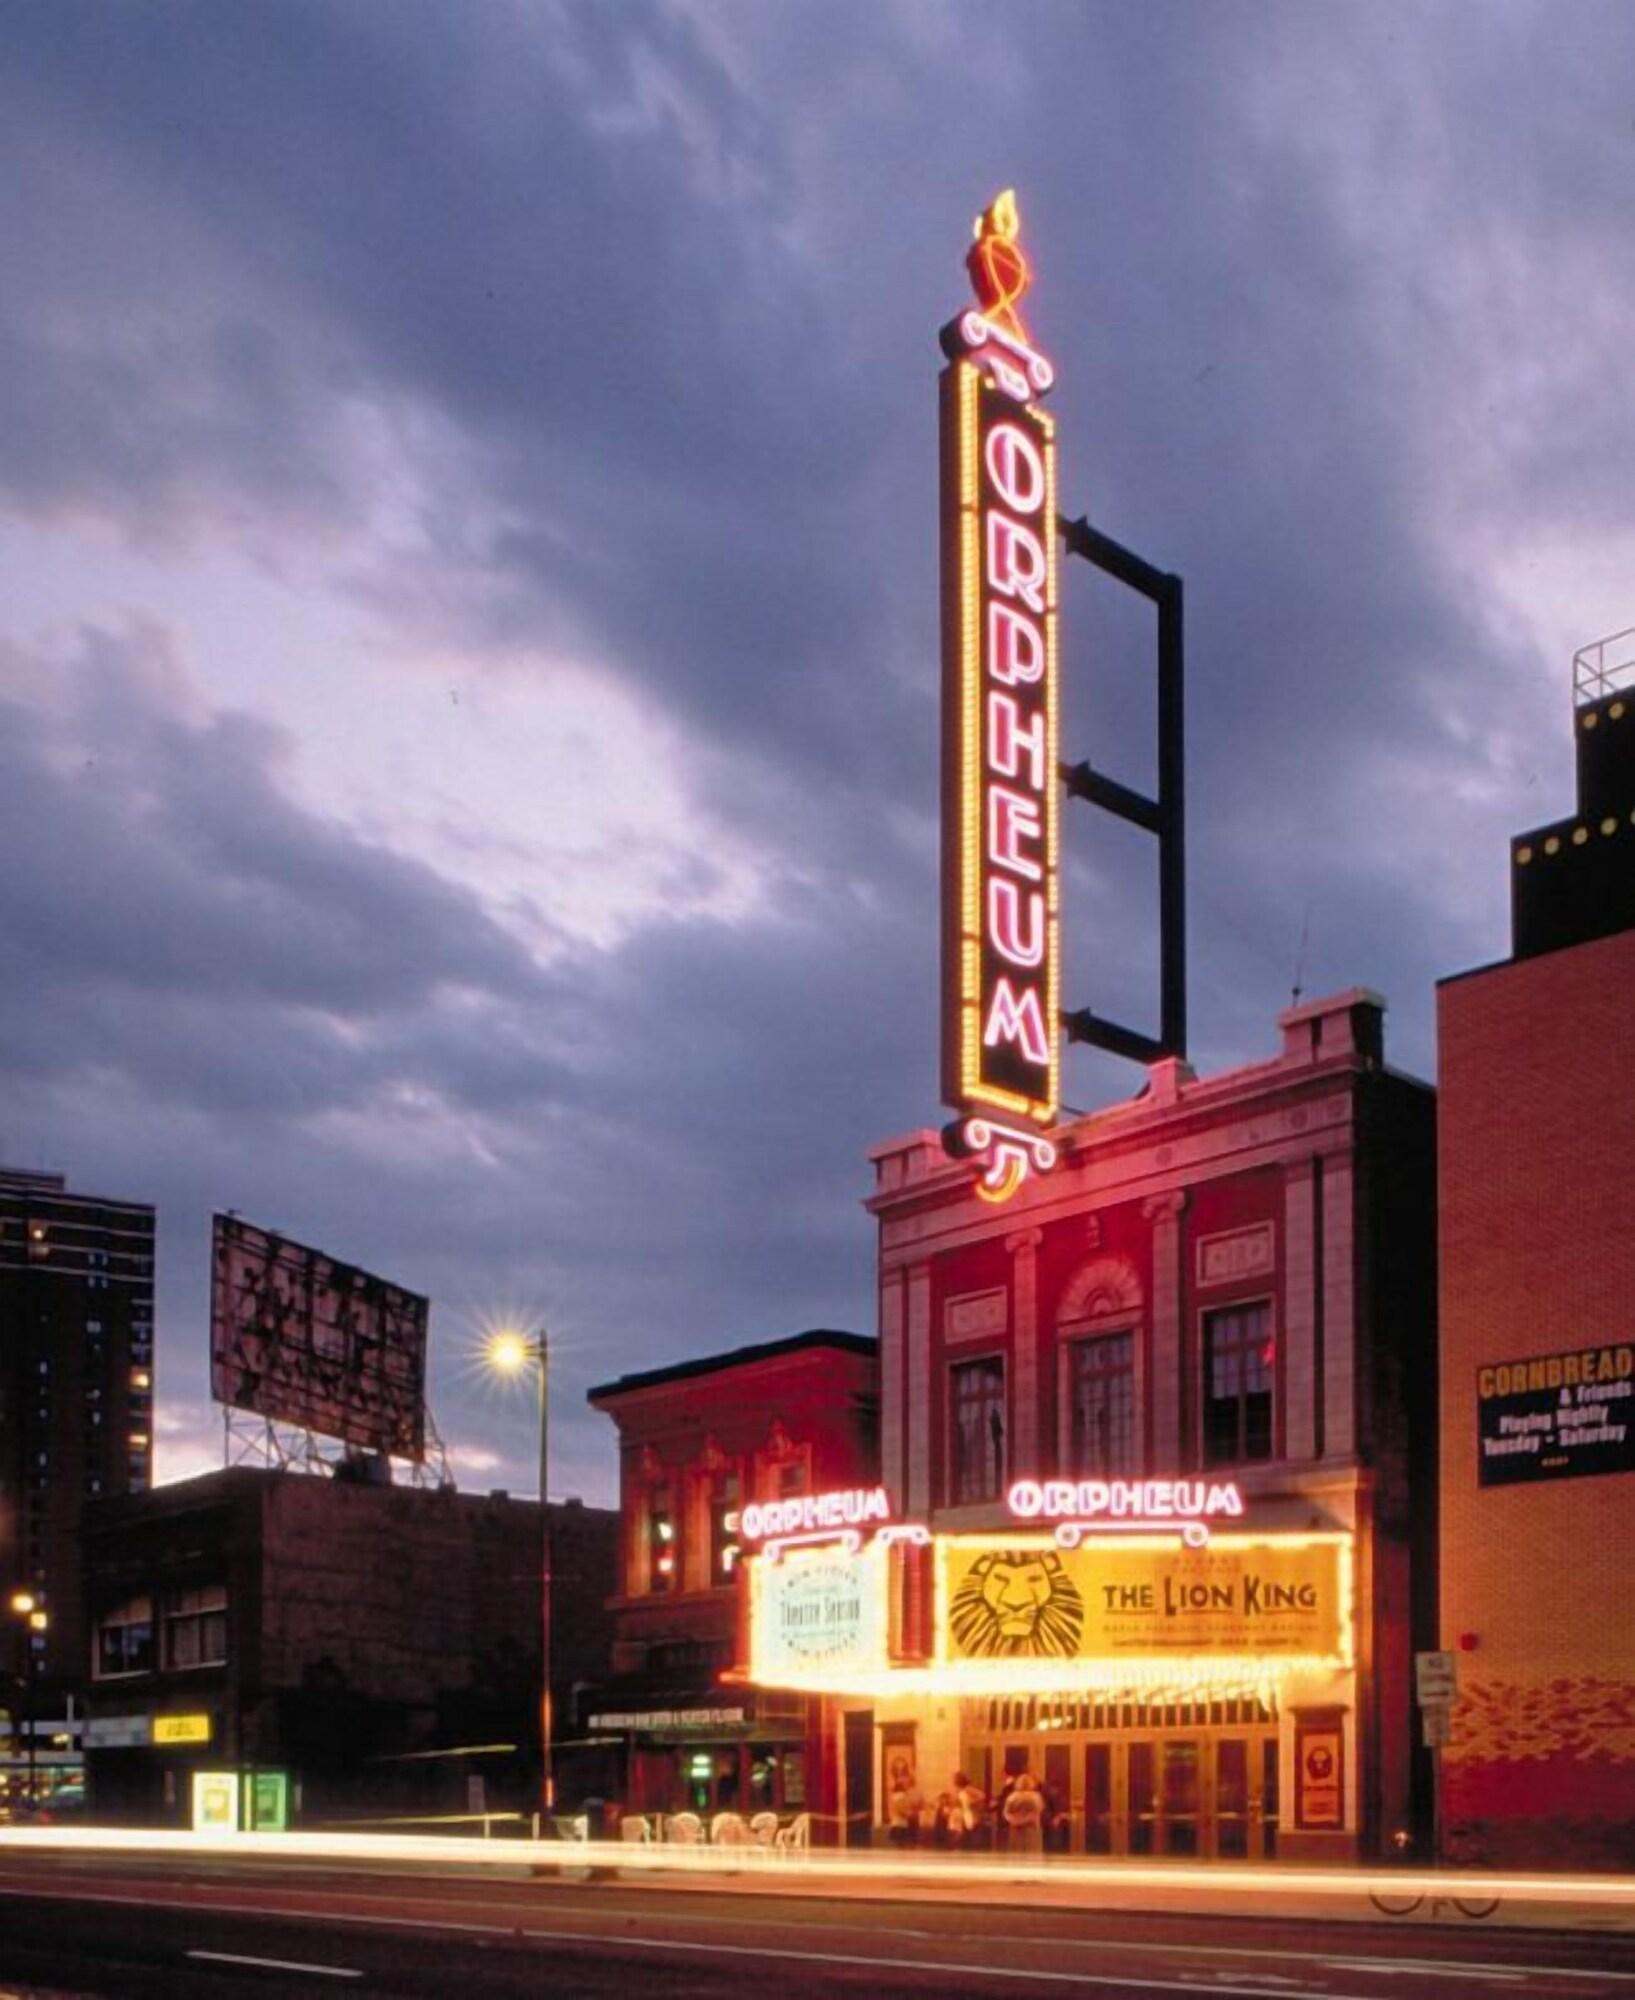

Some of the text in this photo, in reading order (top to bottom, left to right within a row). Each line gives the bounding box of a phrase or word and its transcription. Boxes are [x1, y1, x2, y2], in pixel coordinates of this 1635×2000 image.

[985, 422, 1049, 1066] ORPHEUM
[1479, 1348, 1632, 1398] CORNBREAD
[1577, 1380, 1631, 1403] Friends
[1500, 1404, 1608, 1434] Playing Nightly
[1559, 1424, 1626, 1446] Saturday
[742, 1487, 890, 1539] ORPHEUM
[1008, 1479, 1243, 1518] ORPHEUM
[1103, 1574, 1316, 1616] THE LION KING
